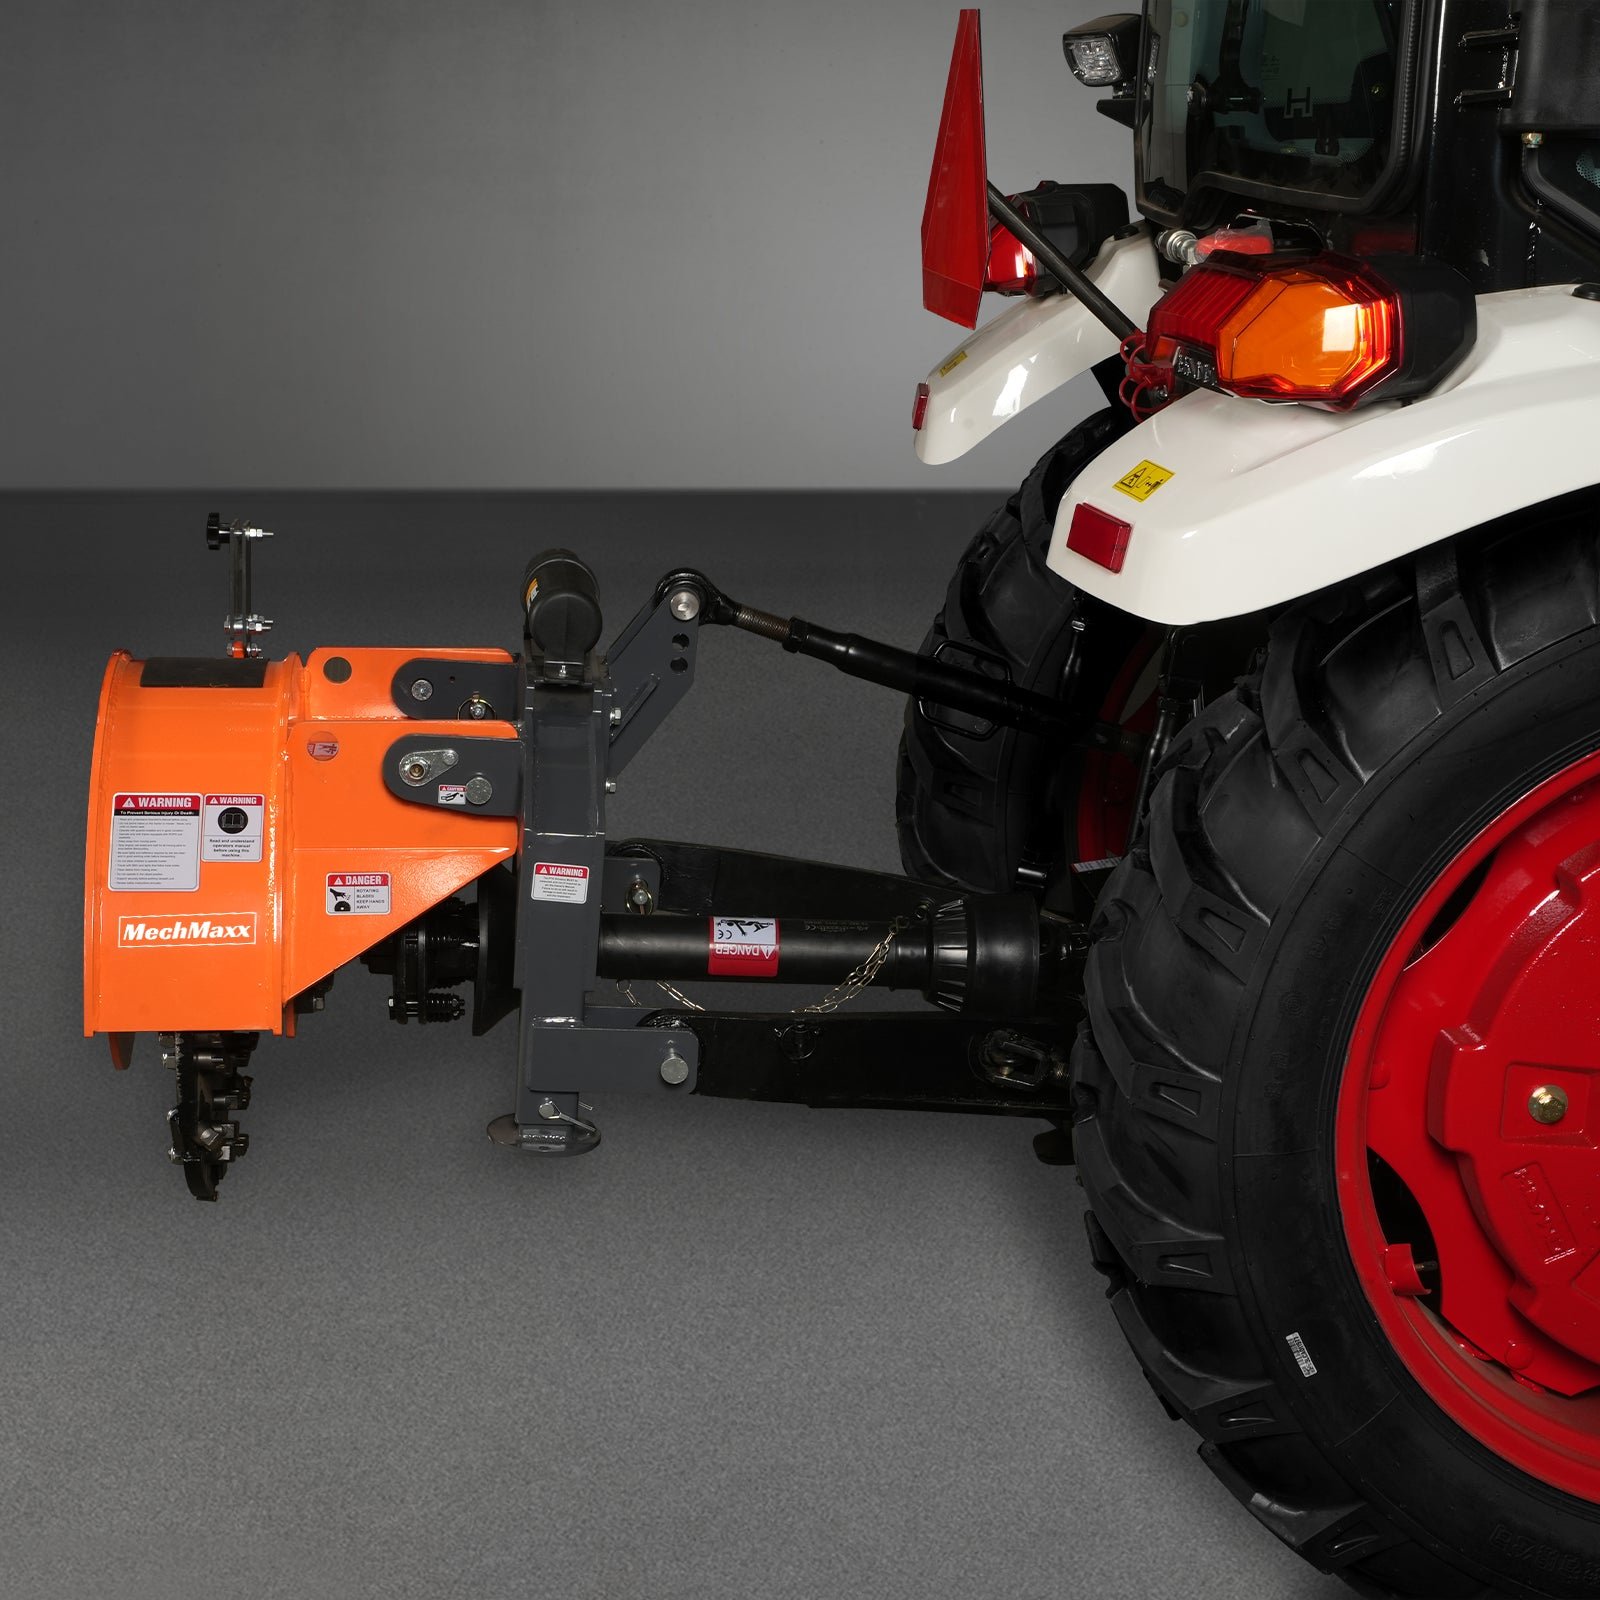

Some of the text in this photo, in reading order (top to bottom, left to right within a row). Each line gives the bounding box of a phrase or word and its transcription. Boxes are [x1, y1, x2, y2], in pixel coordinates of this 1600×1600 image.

[138, 797, 192, 808] WARNING
[219, 796, 257, 804] WARNING
[549, 866, 584, 877] WARNING
[345, 876, 382, 885] DANGER
[123, 920, 252, 941] MechMaxx
[715, 944, 760, 956] DANGER
